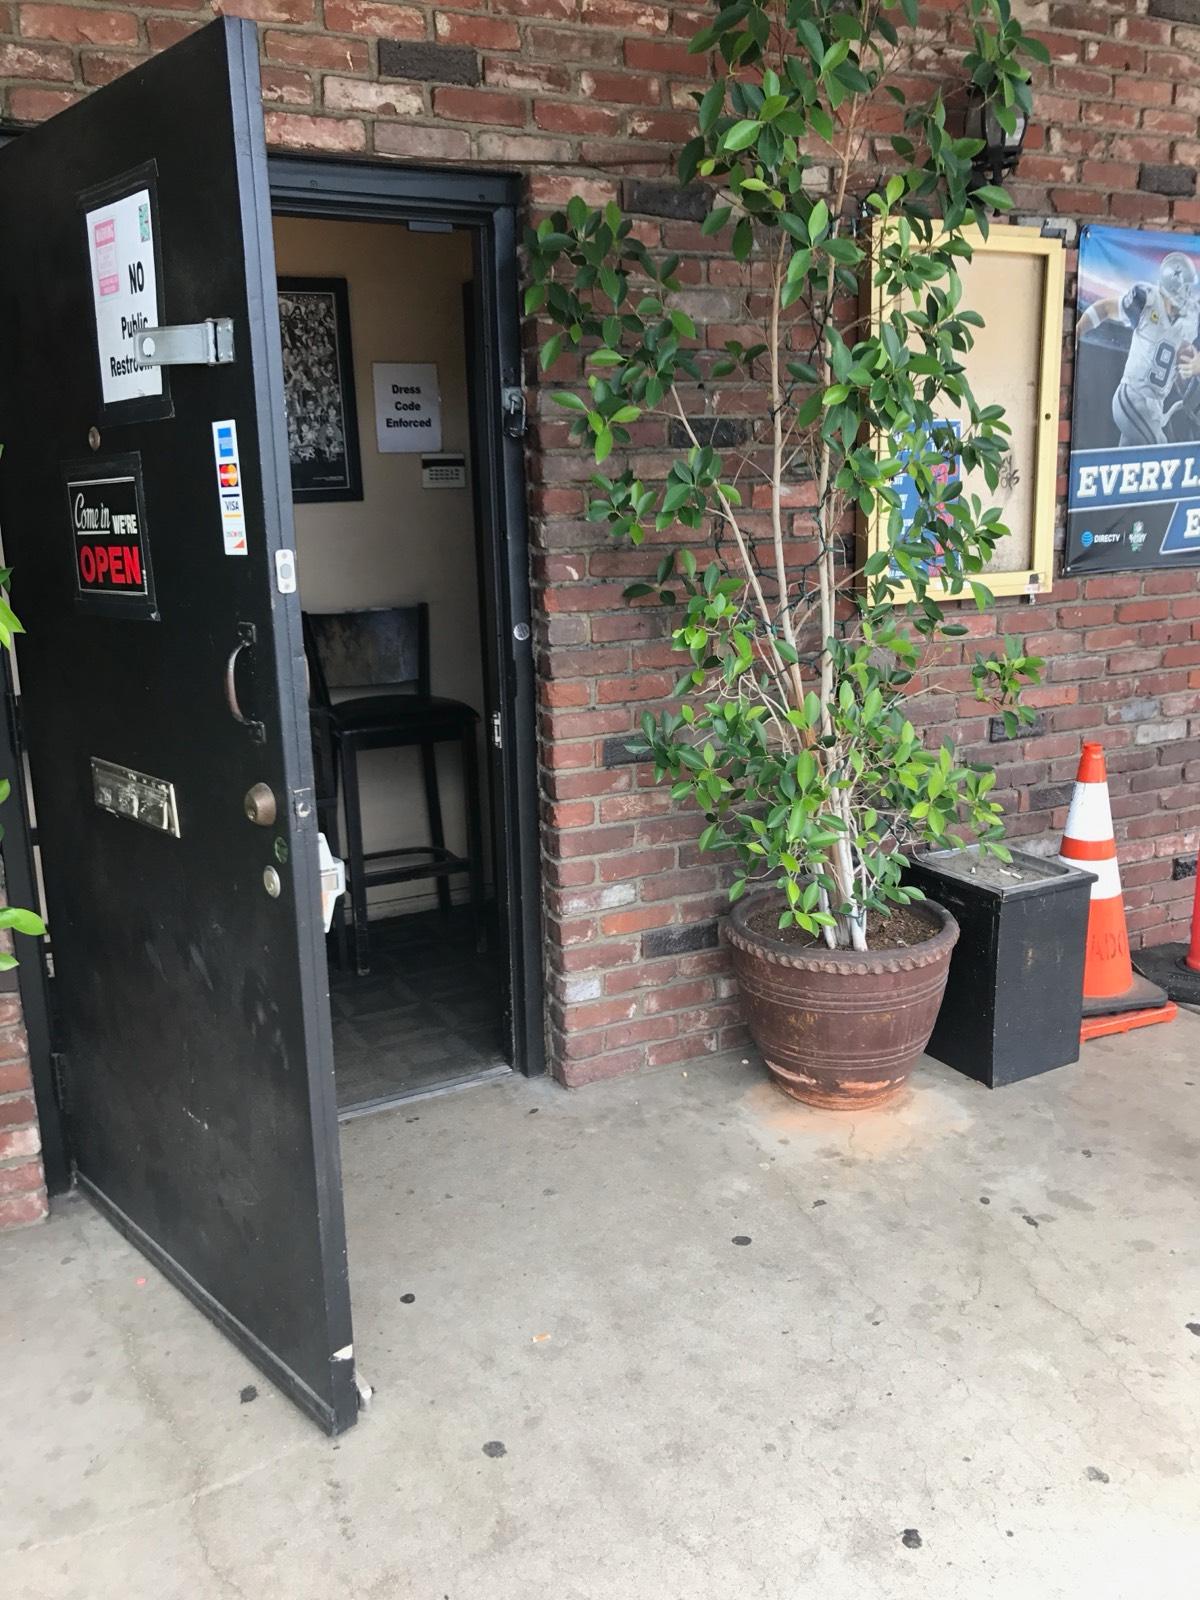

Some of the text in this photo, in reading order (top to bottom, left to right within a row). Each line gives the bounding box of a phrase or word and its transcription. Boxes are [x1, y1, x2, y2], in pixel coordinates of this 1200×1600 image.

[128, 261, 144, 294] NO
[110, 354, 153, 377] Restro
[1150, 342, 1175, 387] 9
[392, 385, 420, 394] Dress
[394, 401, 421, 411] Code
[385, 418, 432, 428] Enforced
[1076, 457, 1200, 498] EVERY L
[75, 493, 138, 535] Come in WE'RE
[224, 501, 240, 511] VISA
[1094, 533, 1120, 543] DIRECTV
[81, 547, 141, 584] OPEN
